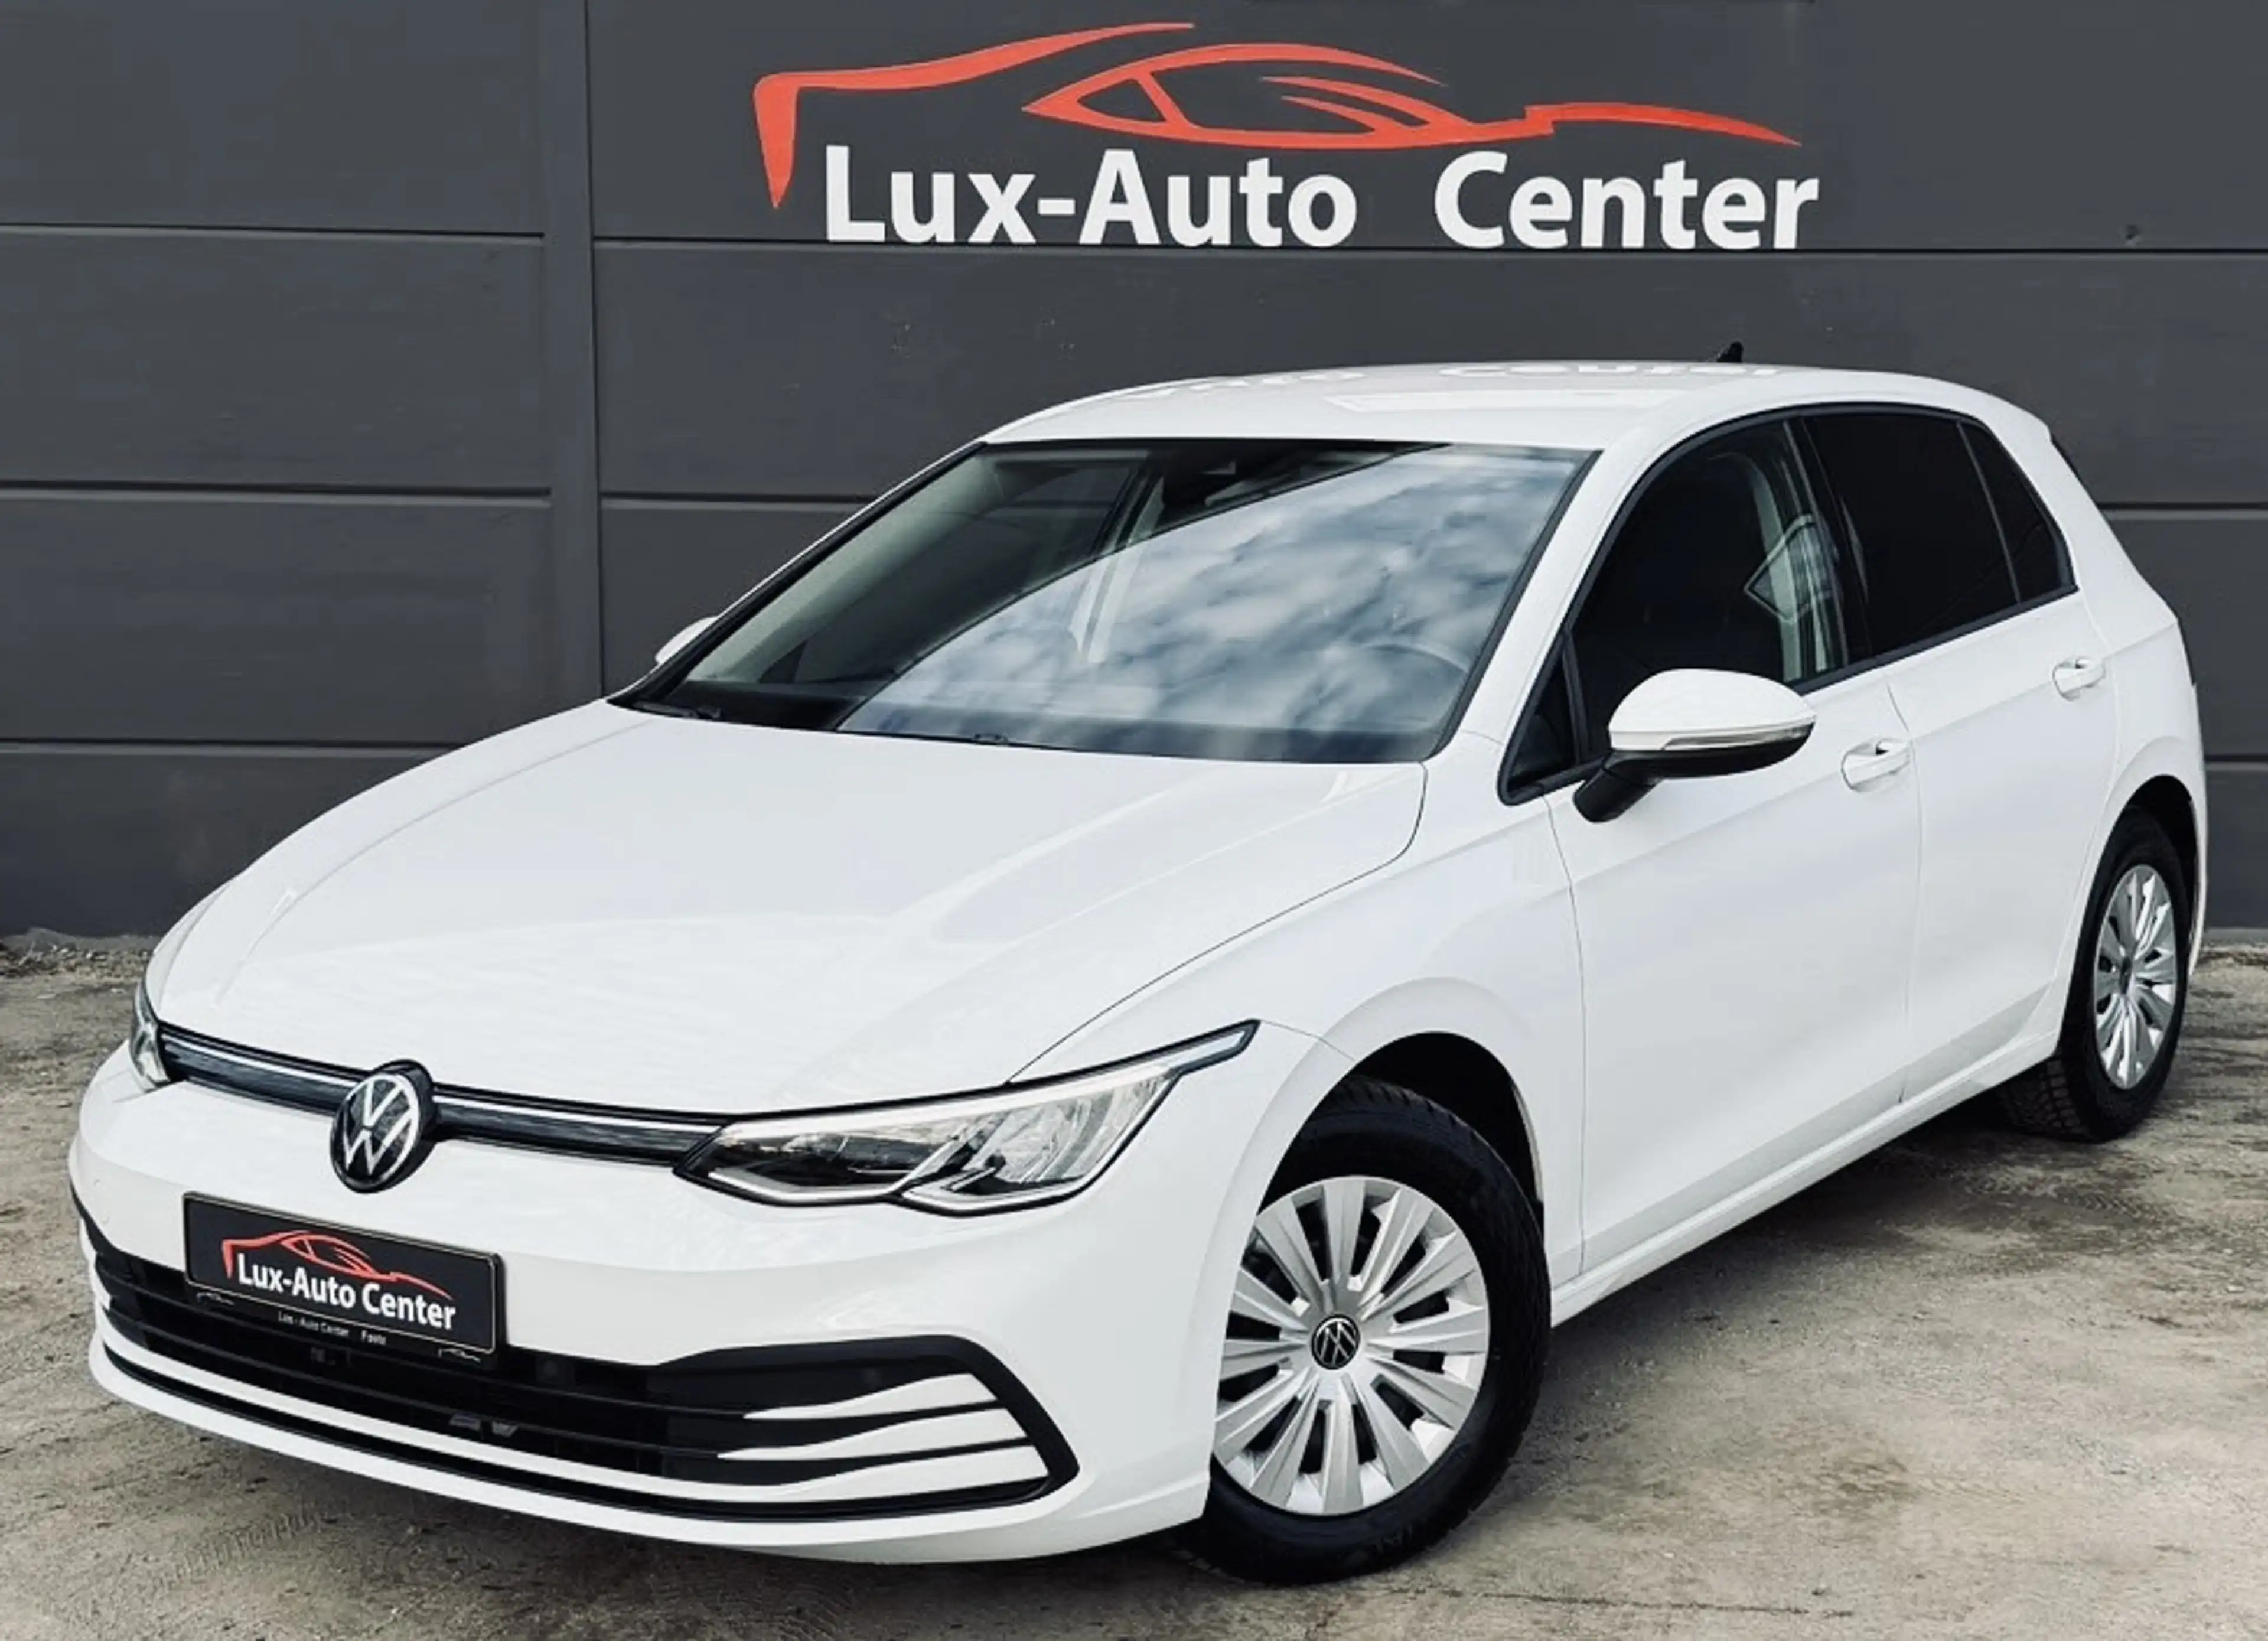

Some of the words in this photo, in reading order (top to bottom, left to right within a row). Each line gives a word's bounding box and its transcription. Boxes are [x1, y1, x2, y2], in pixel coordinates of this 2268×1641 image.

[826, 144, 1357, 248] Lux-Auto
[1434, 150, 1820, 250] Center
[237, 1252, 356, 1309] Lux-Auto
[361, 1282, 457, 1330] Center
